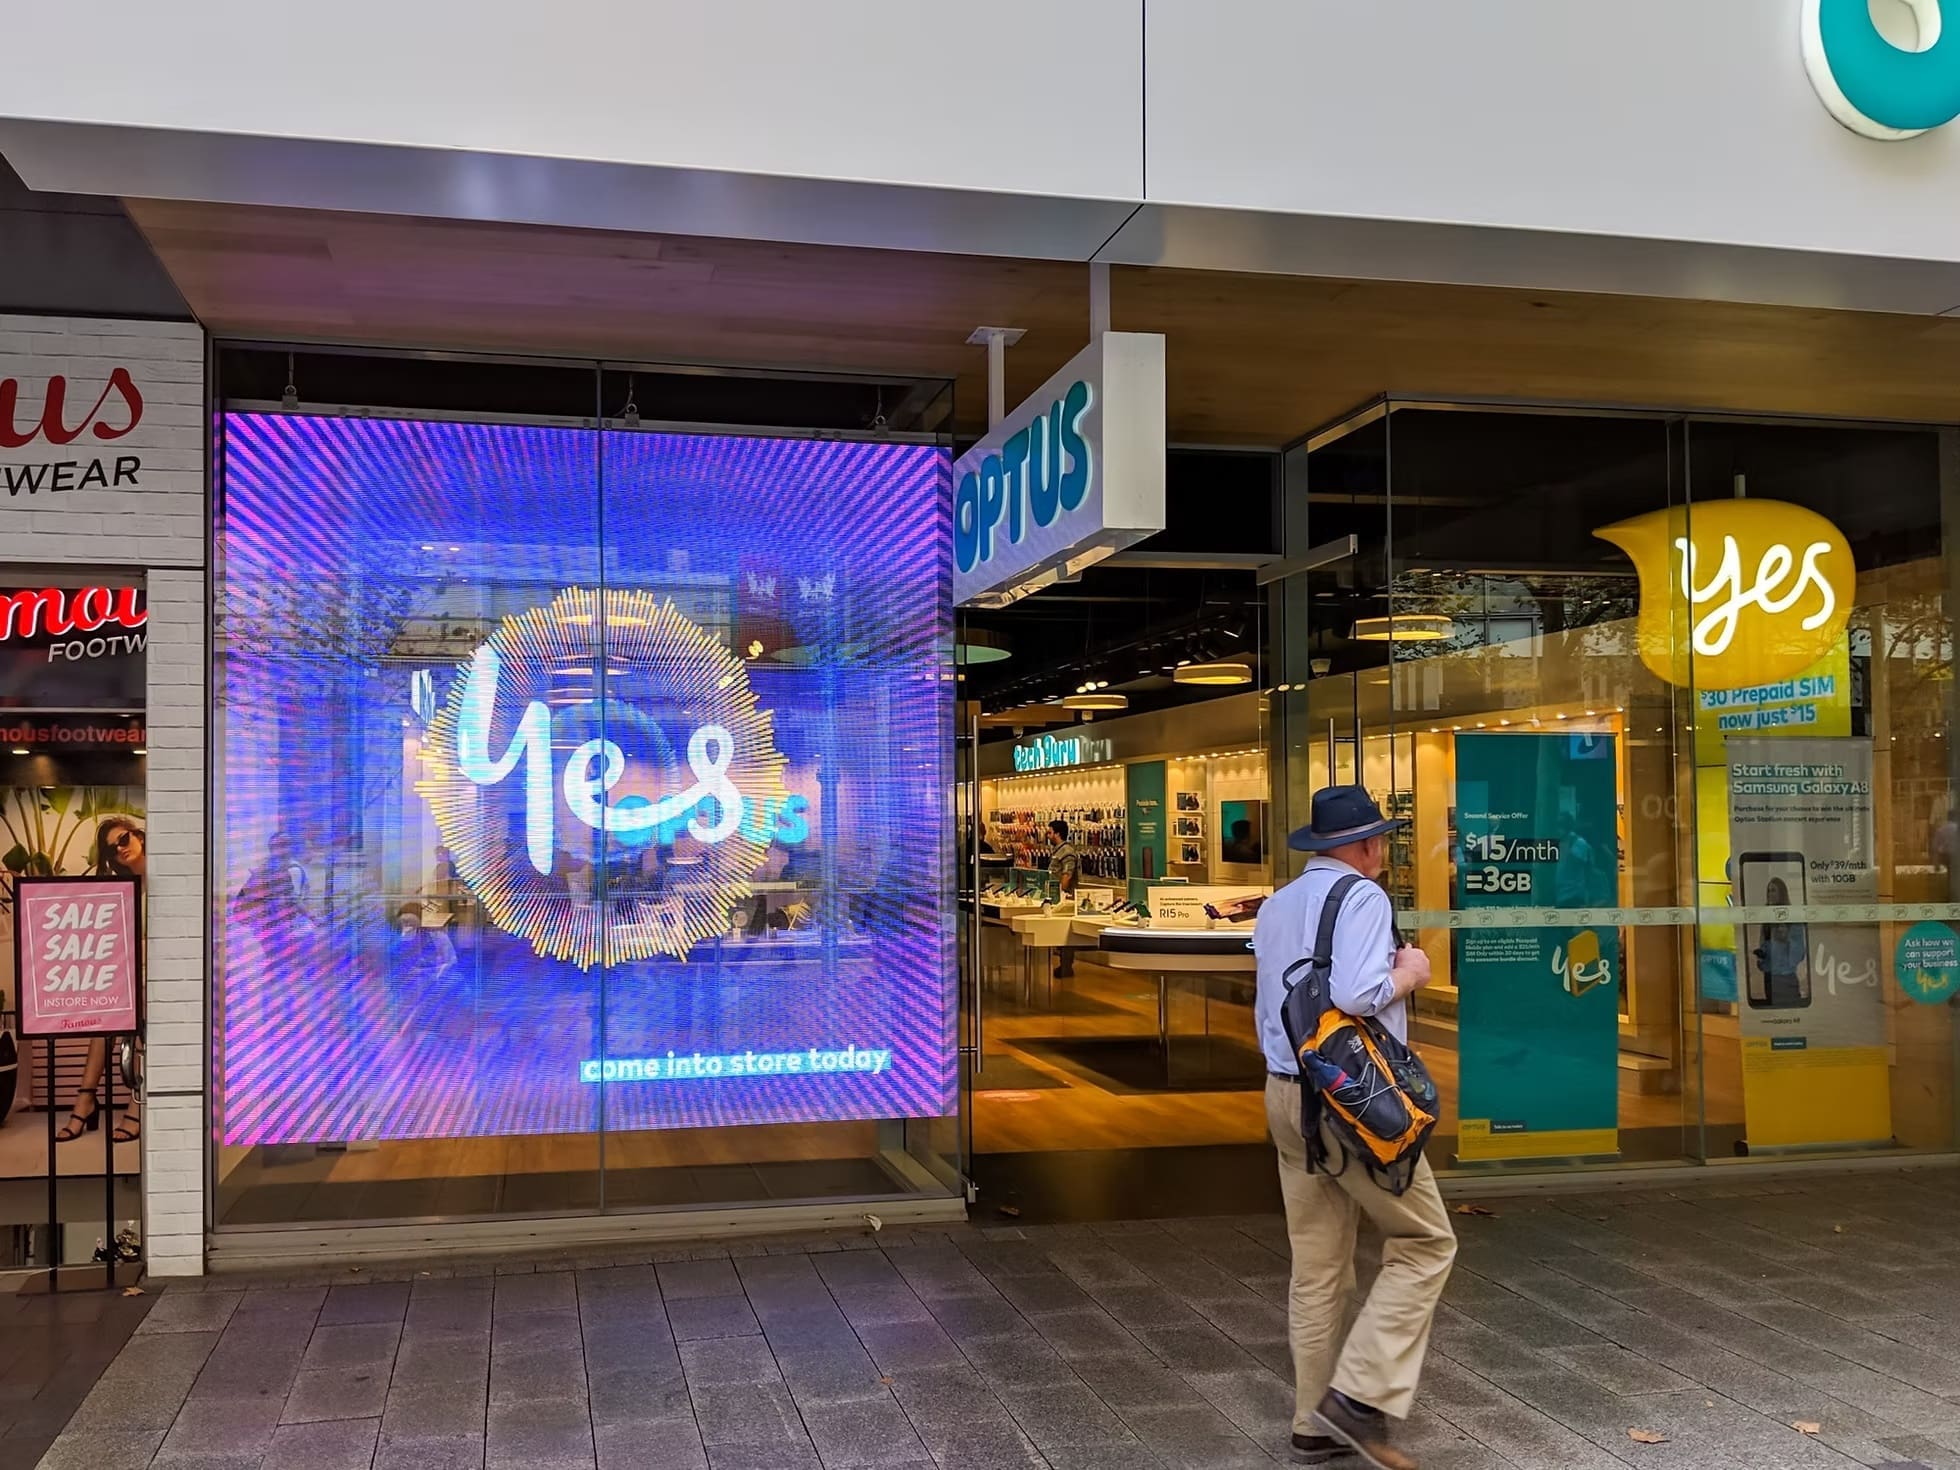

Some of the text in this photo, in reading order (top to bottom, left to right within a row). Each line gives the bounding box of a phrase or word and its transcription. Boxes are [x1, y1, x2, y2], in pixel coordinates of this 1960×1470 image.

[0, 456, 141, 497] WEAR
[954, 380, 1094, 574] OPTUS
[1675, 535, 1835, 656] yes
[1732, 679, 1794, 706] Prepaid
[1799, 675, 1834, 697] SIM
[1719, 703, 1816, 730] now just $15
[1732, 763, 1843, 777] Start fresh with
[1733, 780, 1869, 797] Samsung Galaxy A8
[1465, 832, 1559, 863] $15/mth
[1810, 860, 1830, 872] Only
[1811, 873, 1856, 884] with 10GB
[42, 902, 118, 931] SALE
[1177, 911, 1190, 919] Pro
[42, 933, 119, 962] SALE
[1904, 938, 1921, 948] Ask
[1922, 938, 1940, 947] how
[1922, 949, 1955, 961] support
[42, 964, 118, 993] SALE
[1551, 945, 1611, 992] yes
[1815, 943, 1879, 996] yes
[1903, 960, 1959, 971] your business
[44, 995, 119, 1008] INSTORE NOW
[583, 1043, 890, 1080] come into store today
